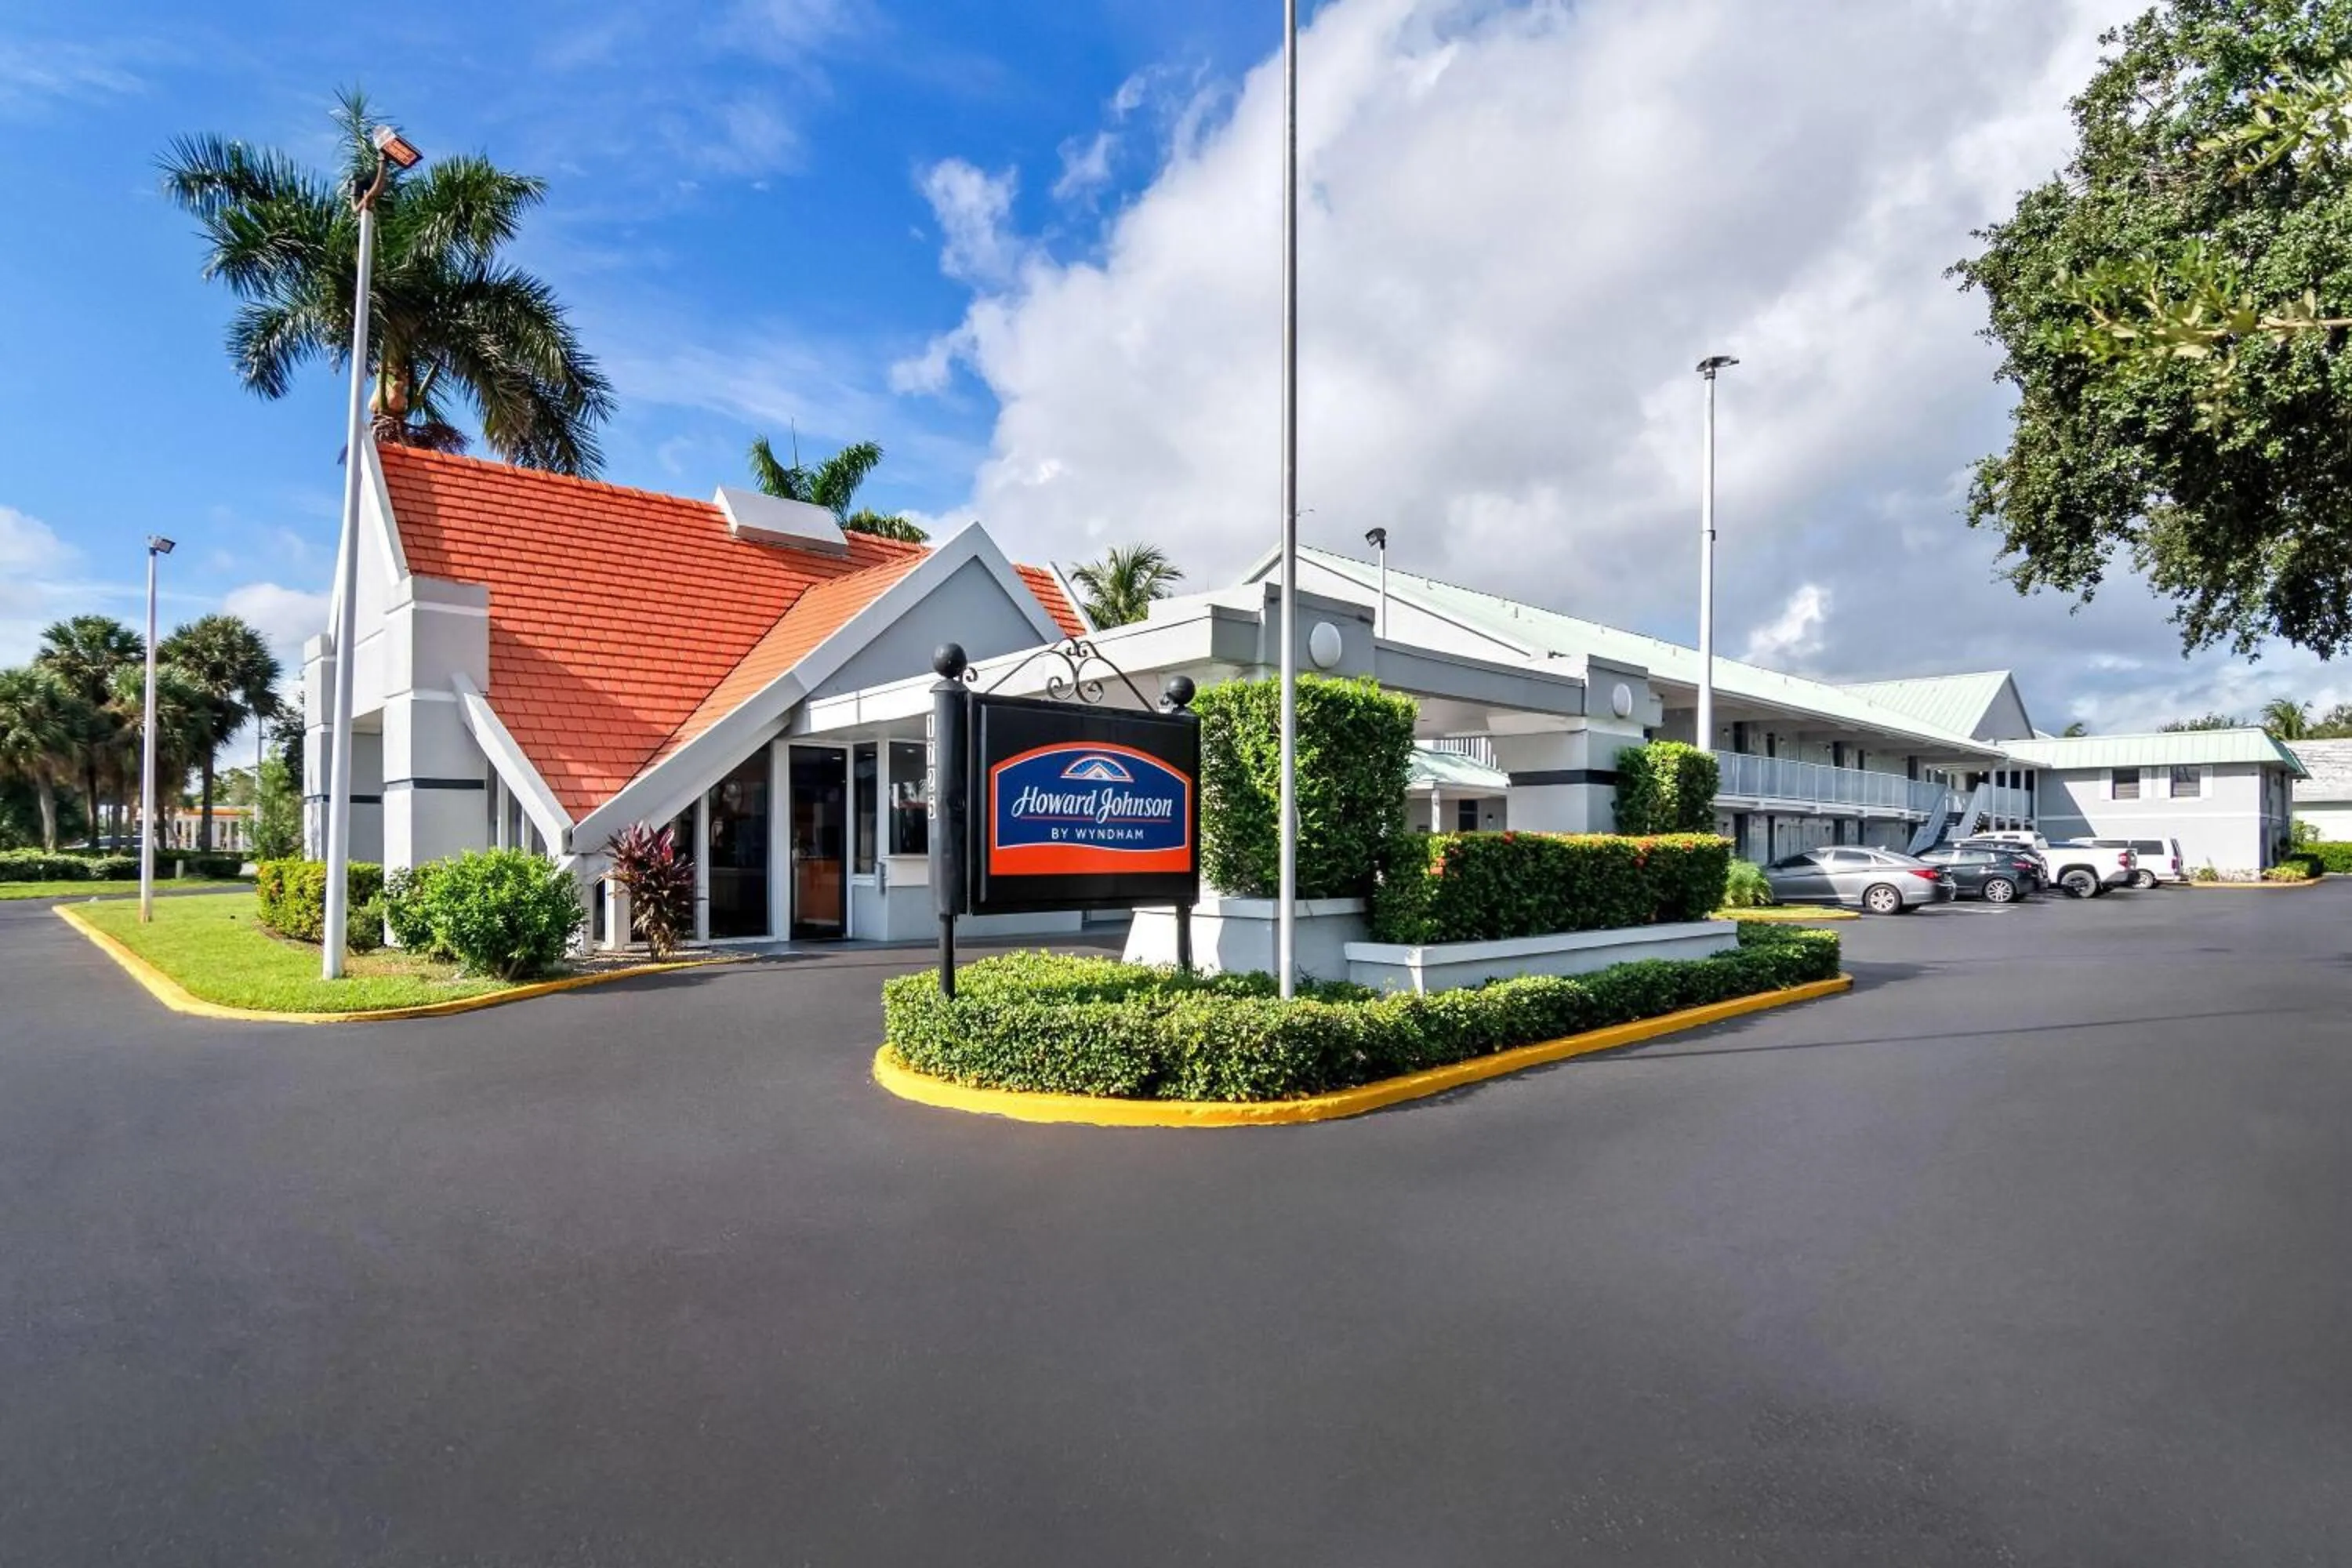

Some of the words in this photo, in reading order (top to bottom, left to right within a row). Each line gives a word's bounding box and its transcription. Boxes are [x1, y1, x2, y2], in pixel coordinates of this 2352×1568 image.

[1011, 786, 1097, 818] Howard
[1095, 788, 1172, 824] Johnson
[1051, 827, 1069, 840] BY
[1076, 828, 1144, 840] WYNDHAM
